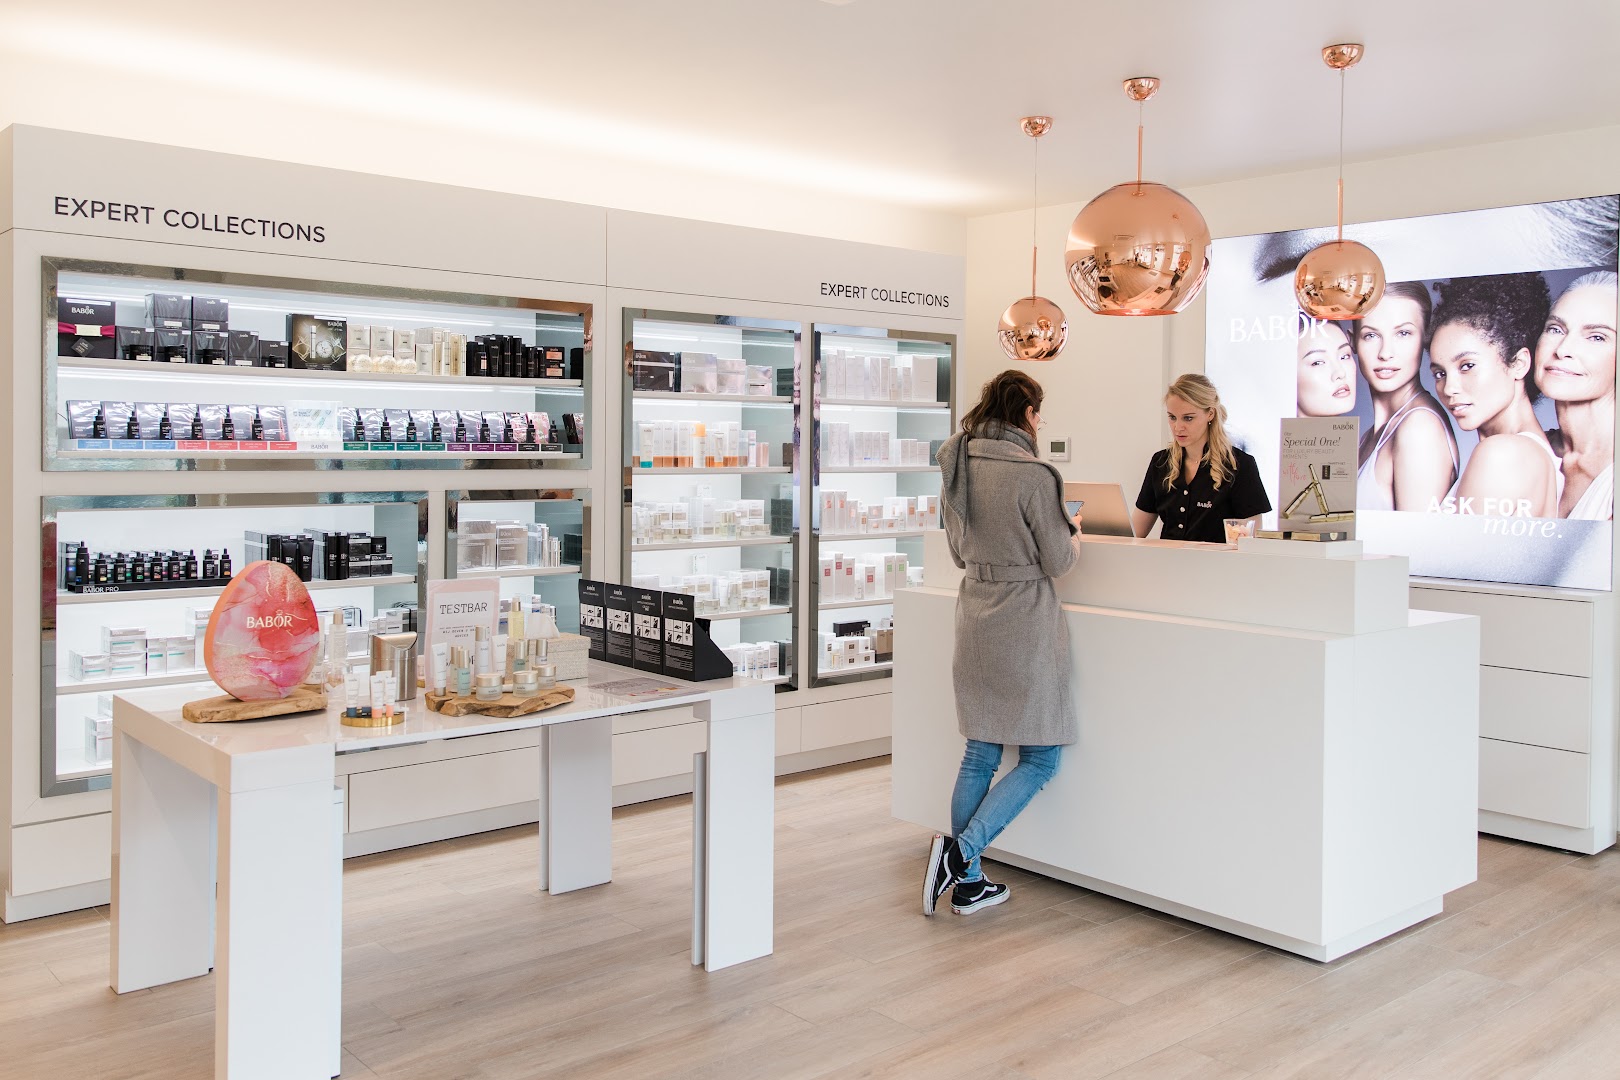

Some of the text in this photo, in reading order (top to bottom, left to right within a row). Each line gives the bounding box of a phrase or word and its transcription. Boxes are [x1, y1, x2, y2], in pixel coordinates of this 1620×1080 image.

[54, 196, 326, 243] EXPERT COLLECTIONS
[820, 282, 949, 307] EXPERT COLLECTIONS
[71, 306, 95, 315] BABOR
[1229, 311, 1331, 342] BABOR
[1332, 423, 1354, 431] BABOR
[1283, 436, 1341, 448] Special One!
[1427, 495, 1532, 518] ASK FOR
[1483, 518, 1563, 539] more.
[439, 602, 488, 615] TESTBAR
[246, 612, 293, 629] BABOR
